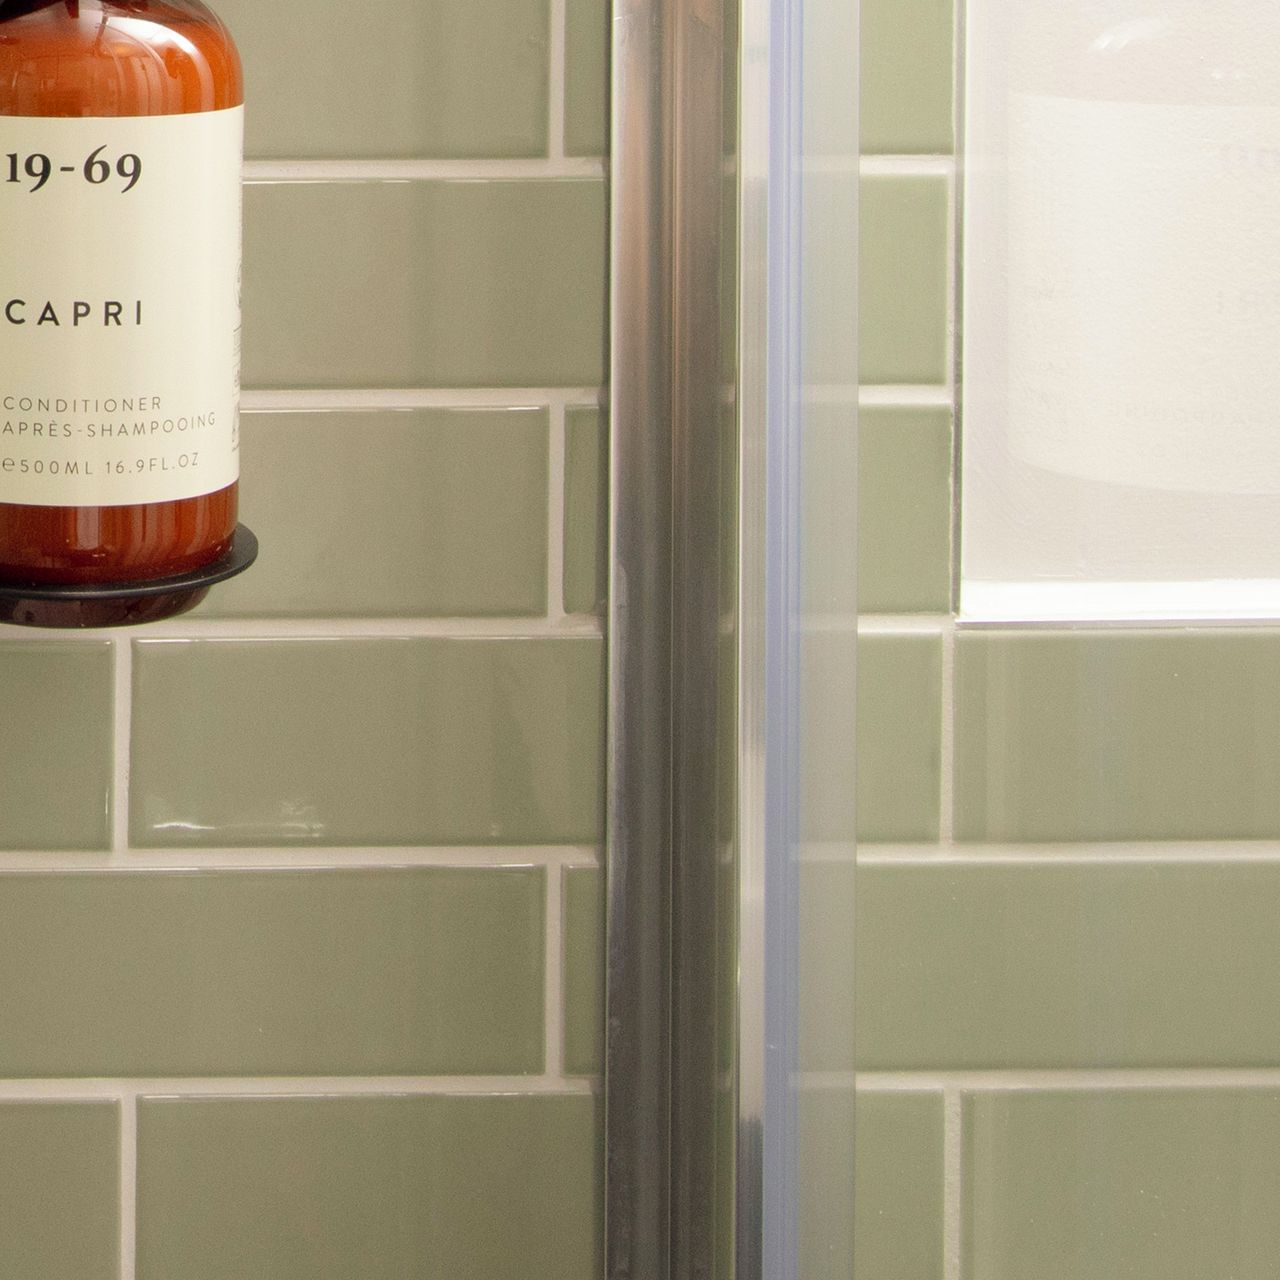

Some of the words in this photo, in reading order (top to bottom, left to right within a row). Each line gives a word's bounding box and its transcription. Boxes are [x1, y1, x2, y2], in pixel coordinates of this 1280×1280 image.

[5, 144, 142, 194] 19-69
[4, 298, 142, 327] CAPRI
[2, 396, 162, 414] CONDITIONER
[2, 412, 216, 438] APRÈS-SHAMPOOING
